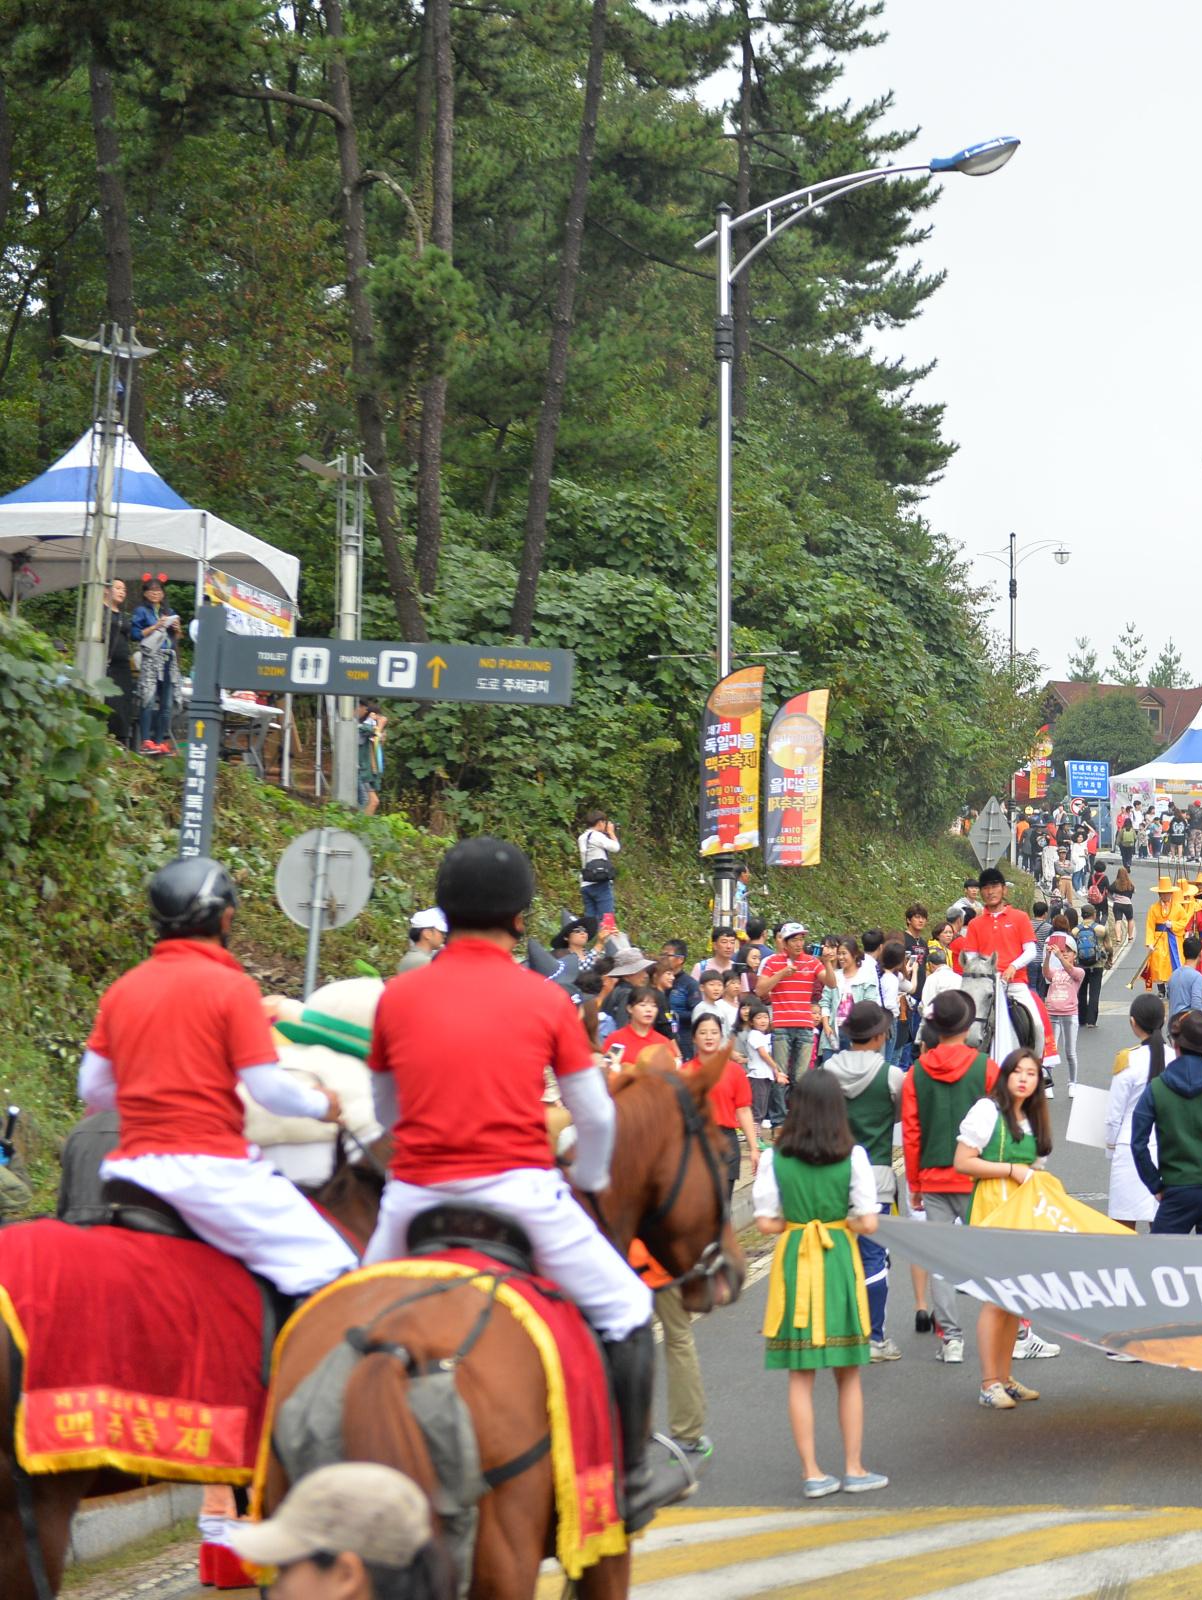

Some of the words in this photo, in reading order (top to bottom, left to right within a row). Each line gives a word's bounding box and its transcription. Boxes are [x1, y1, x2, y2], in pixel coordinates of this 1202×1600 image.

[257, 651, 289, 661] TOILET
[338, 655, 378, 665] PARKING
[388, 657, 409, 683] P
[479, 658, 497, 669] NO
[498, 658, 552, 673] PARKING
[476, 678, 500, 690] 도로
[502, 678, 550, 694] 주차금지
[707, 722, 731, 735] 제7회
[704, 733, 755, 753] 독일마을
[705, 751, 758, 771] 맥주축제
[56, 1410, 212, 1458] 맥주축제
